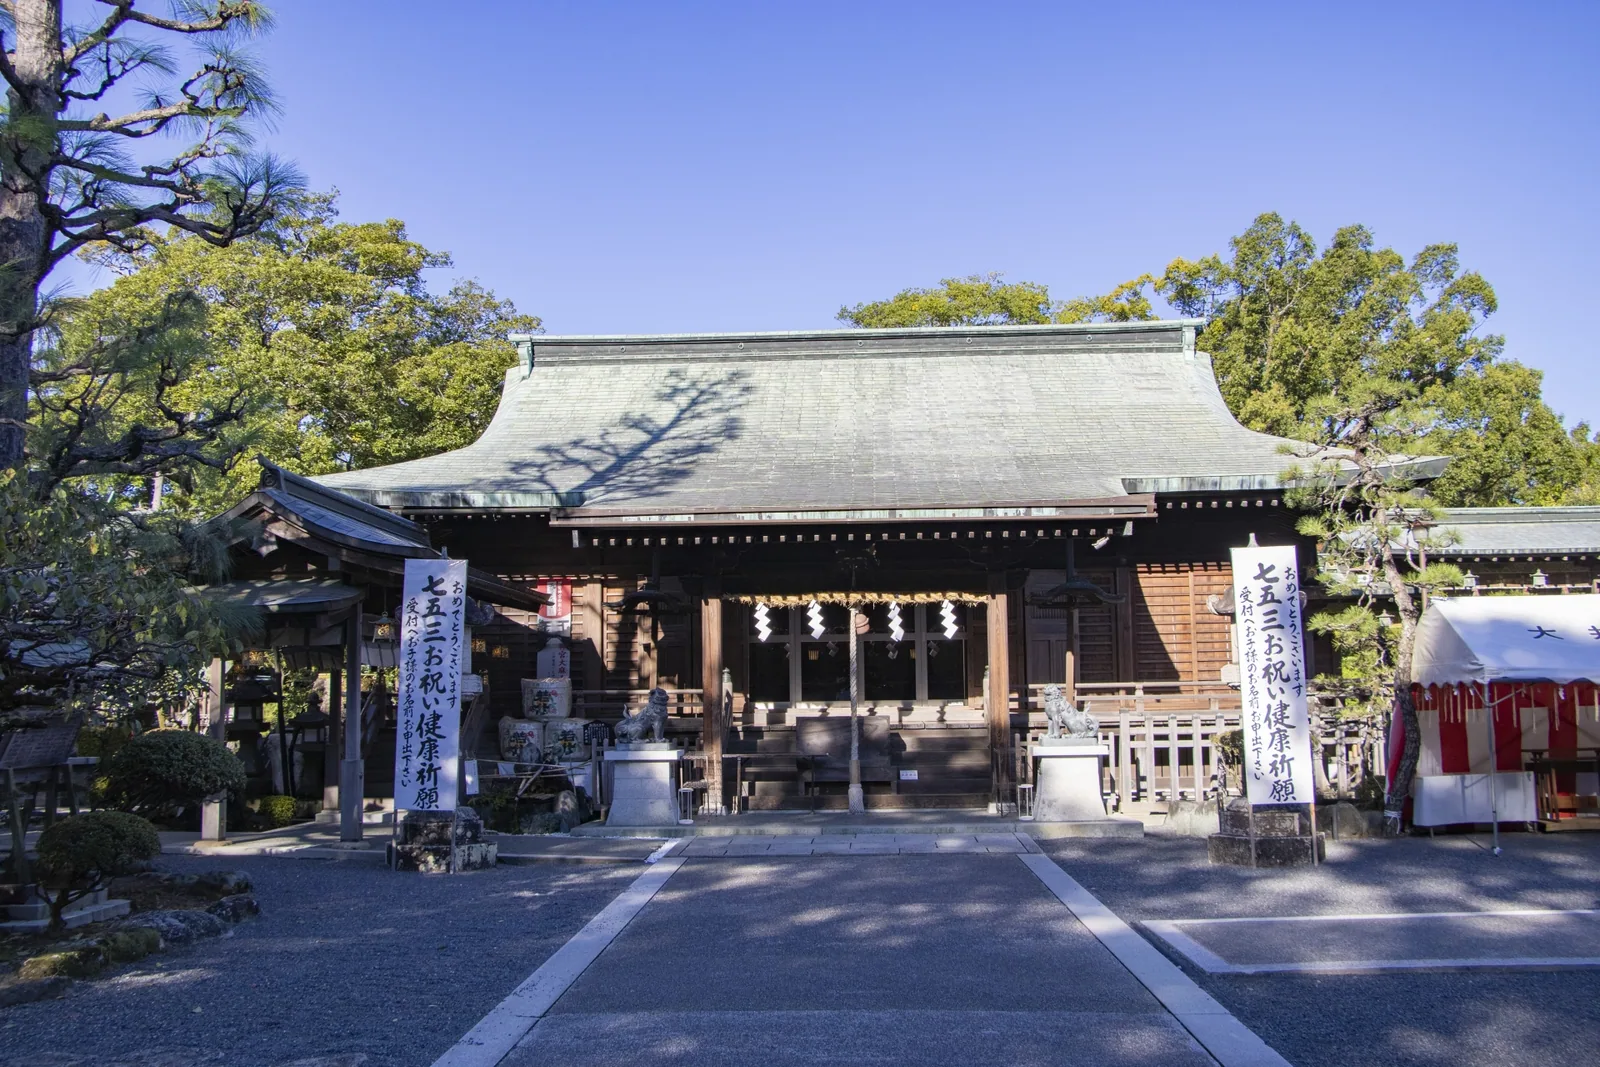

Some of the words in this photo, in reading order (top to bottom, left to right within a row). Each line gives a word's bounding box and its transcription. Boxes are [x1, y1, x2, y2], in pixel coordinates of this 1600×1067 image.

[413, 575, 447, 810] 七五三お祝い健康祈願
[447, 580, 464, 709] おめでとうございます
[1253, 562, 1297, 802] 七五三お祝い健康祈願
[1284, 566, 1303, 698] おめでとうございます
